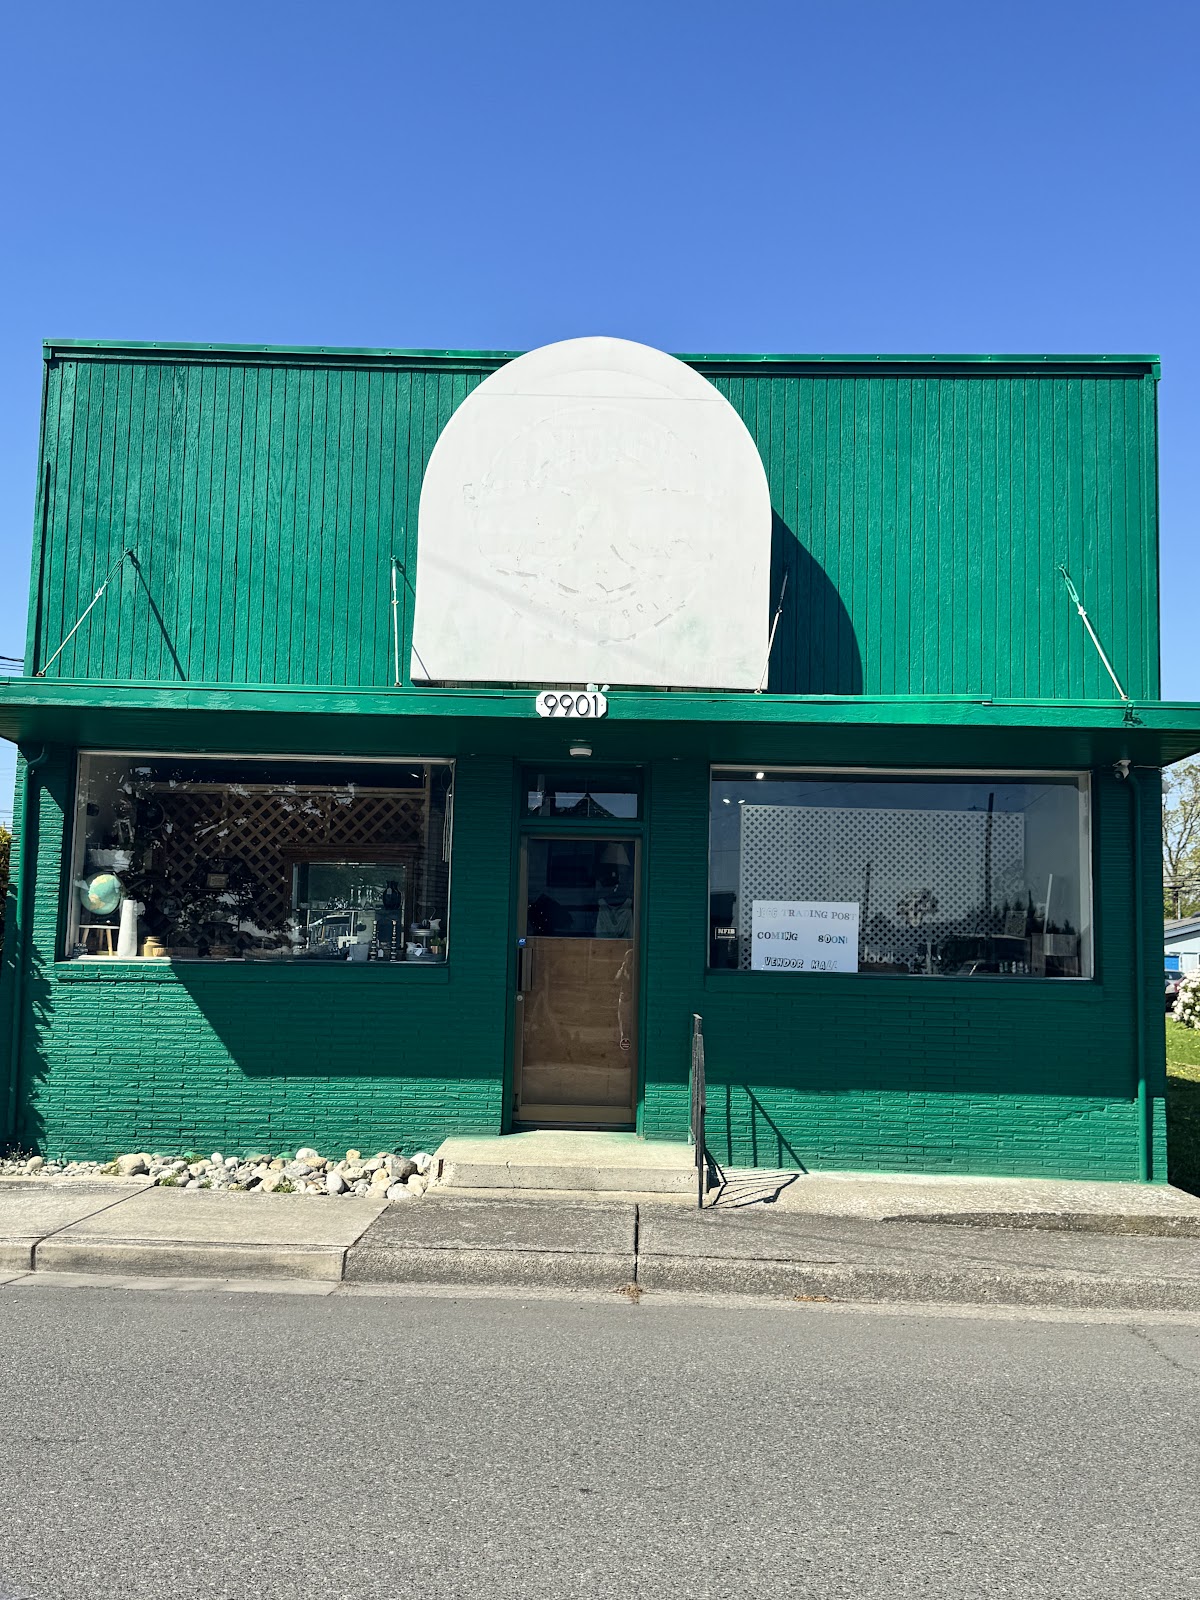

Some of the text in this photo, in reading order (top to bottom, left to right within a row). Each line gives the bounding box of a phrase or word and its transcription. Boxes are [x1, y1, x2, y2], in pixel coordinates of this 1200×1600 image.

[543, 693, 599, 717] 9901
[757, 931, 798, 941] COMING
[765, 956, 804, 969] VENDOR
